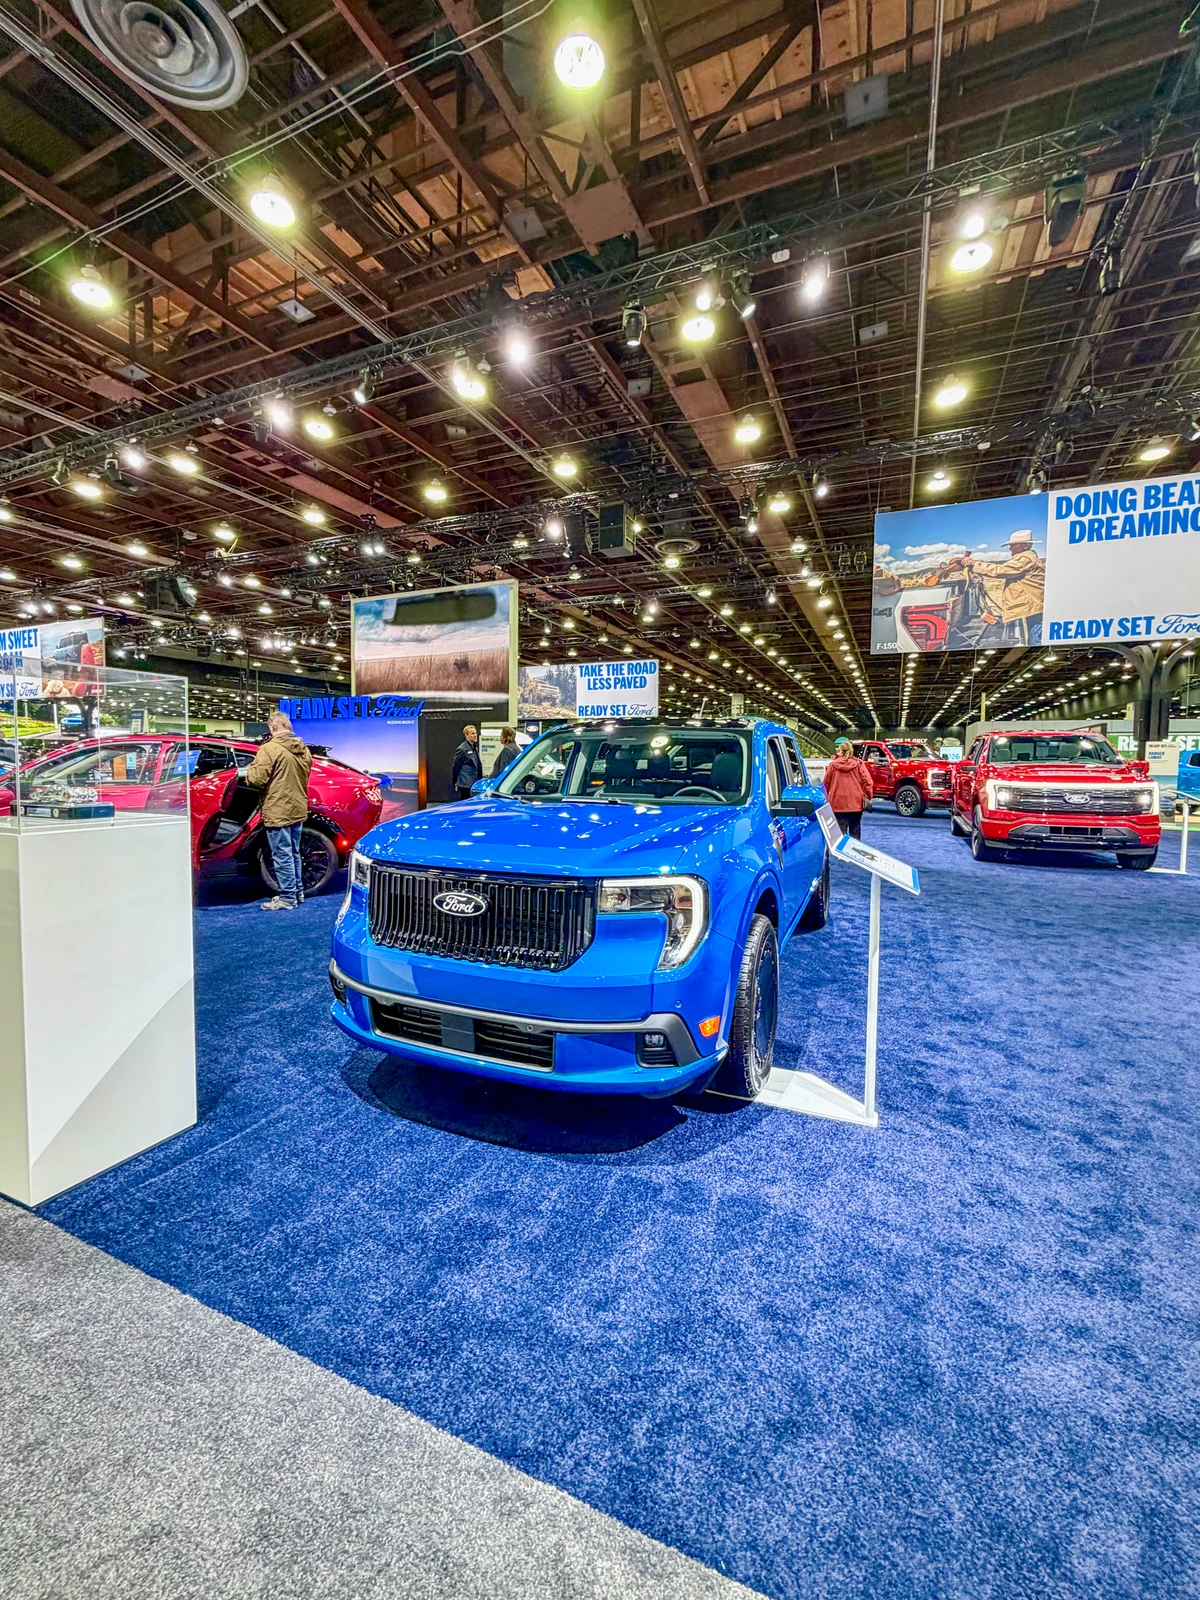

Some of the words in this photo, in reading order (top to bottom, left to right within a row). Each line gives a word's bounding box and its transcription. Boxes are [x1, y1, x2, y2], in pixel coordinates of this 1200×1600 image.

[1055, 487, 1138, 521] DOING
[1048, 618, 1115, 641] READY
[1117, 615, 1156, 637] SET
[8, 628, 39, 651] SWEET
[876, 642, 898, 650] F-150
[0, 651, 23, 671] OAM
[578, 664, 604, 678] TAKE
[605, 662, 625, 676] THE
[627, 661, 657, 675] ROAD
[19, 681, 40, 697] Ford
[587, 677, 612, 691] LESS
[613, 675, 648, 689] PAVED
[278, 697, 334, 719] READY
[336, 695, 371, 718] SET
[370, 694, 425, 718] Ford
[578, 705, 608, 717] READY
[610, 704, 628, 716] SET
[627, 703, 656, 716] Ford
[1175, 735, 1200, 752] SE
[442, 894, 476, 913] Ford
